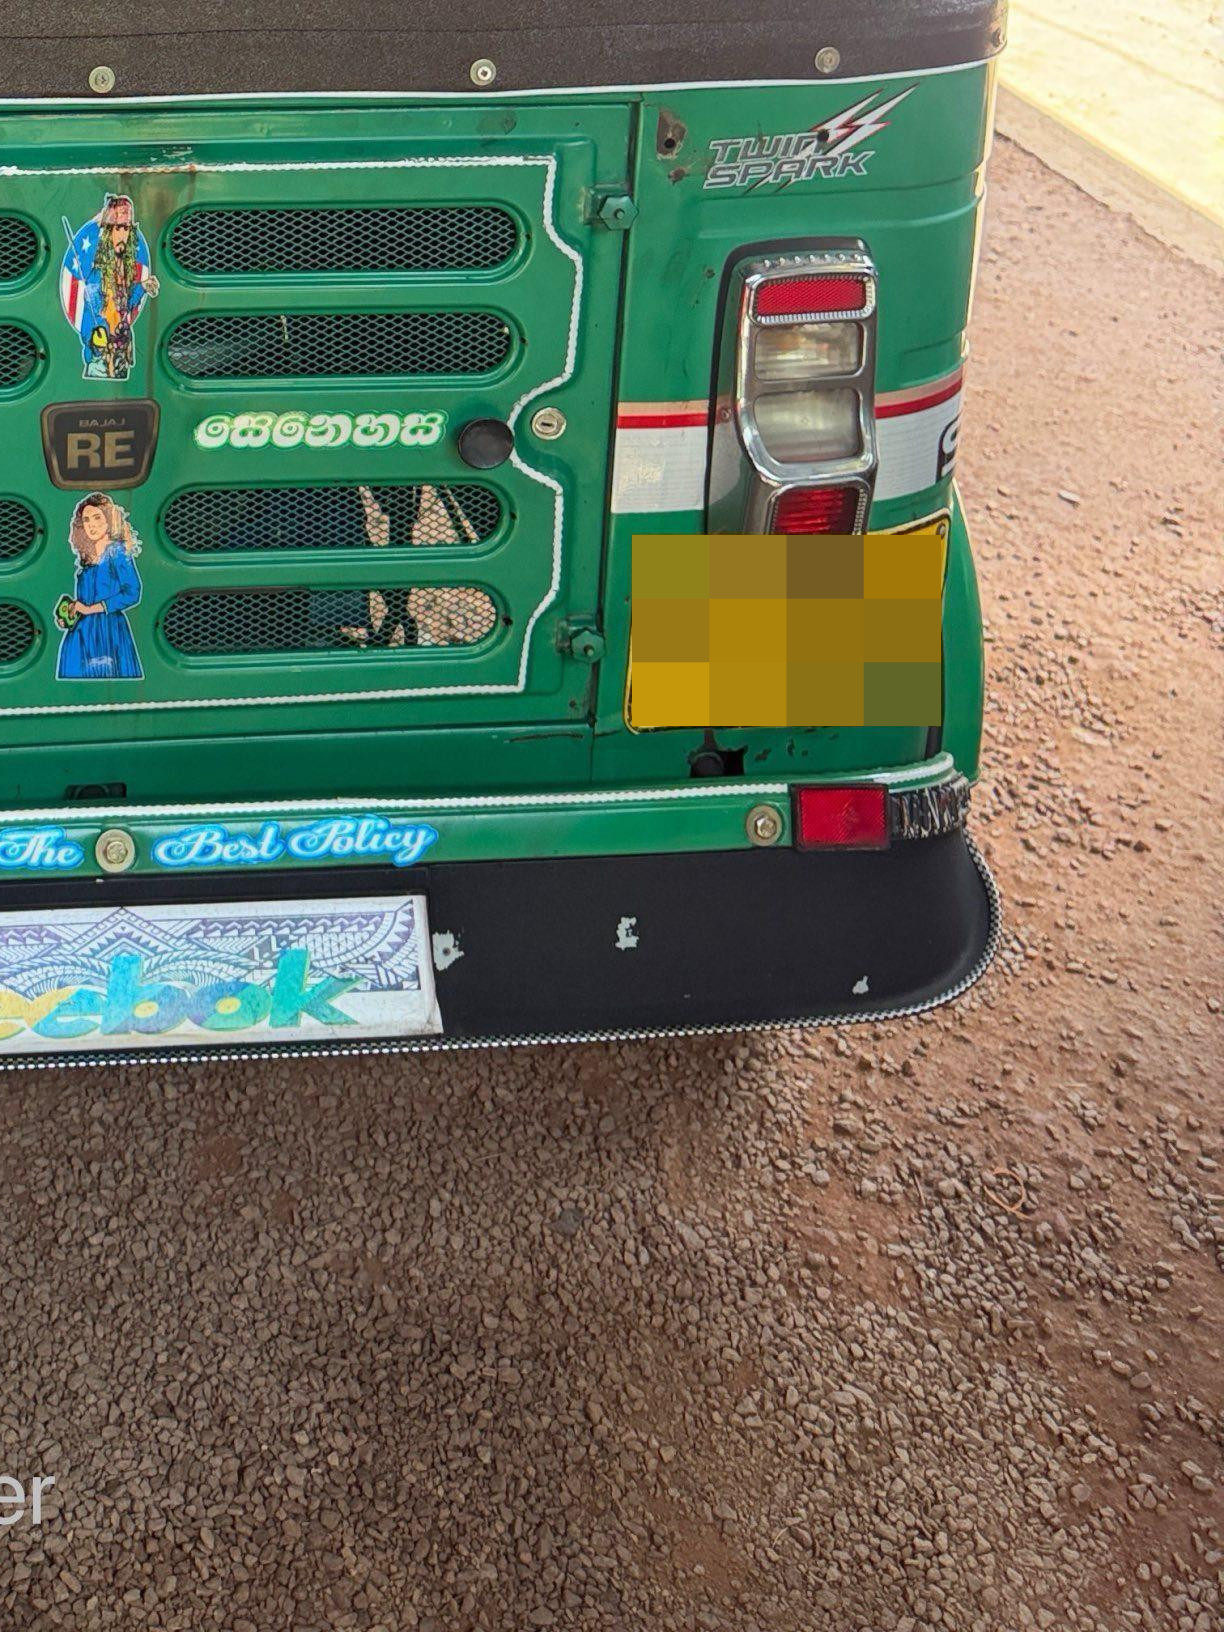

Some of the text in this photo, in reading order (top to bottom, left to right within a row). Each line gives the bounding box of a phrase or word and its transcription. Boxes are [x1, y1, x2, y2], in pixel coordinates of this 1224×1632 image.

[709, 132, 825, 164] TWIN
[703, 151, 876, 190] SPARK
[78, 417, 126, 428] BAJAJ
[193, 411, 447, 449] සෙනෙහස
[67, 430, 135, 469] RE
[151, 814, 439, 867] Best Policy
